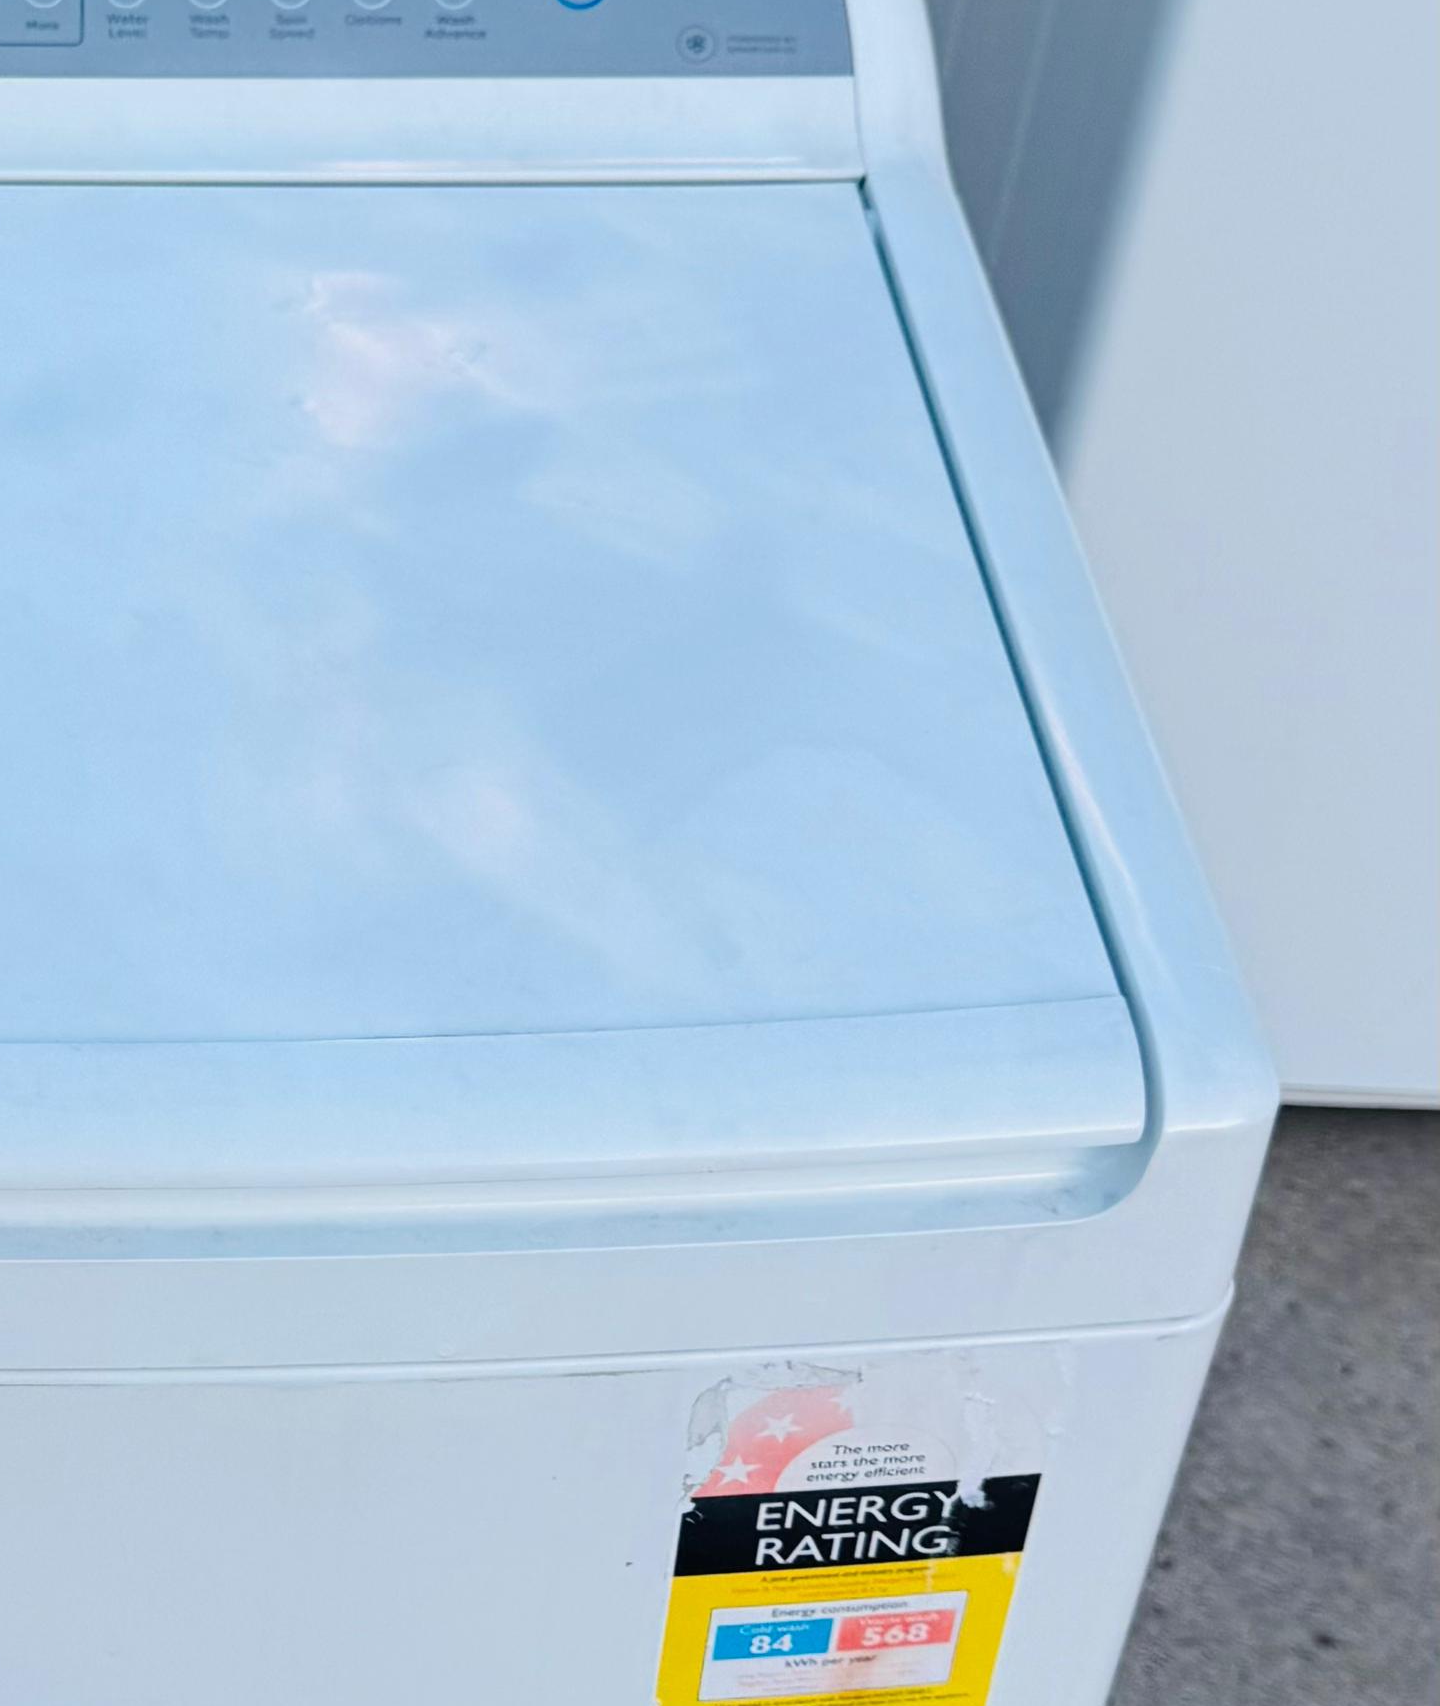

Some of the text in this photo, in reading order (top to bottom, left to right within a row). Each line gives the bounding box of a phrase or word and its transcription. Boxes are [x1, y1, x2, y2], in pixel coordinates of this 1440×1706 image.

[833, 1443, 910, 1455] The more
[811, 1454, 926, 1469] stars the more
[806, 1467, 926, 1482] energy efficient
[755, 1491, 960, 1531] ENERGY
[754, 1525, 948, 1566] RATING
[772, 1601, 908, 1618] Energy consumption
[904, 1612, 940, 1622] wash
[739, 1623, 809, 1635] Cold wash
[862, 1623, 931, 1647] 568
[749, 1634, 793, 1654] 84
[784, 1654, 877, 1668] kWh per year
